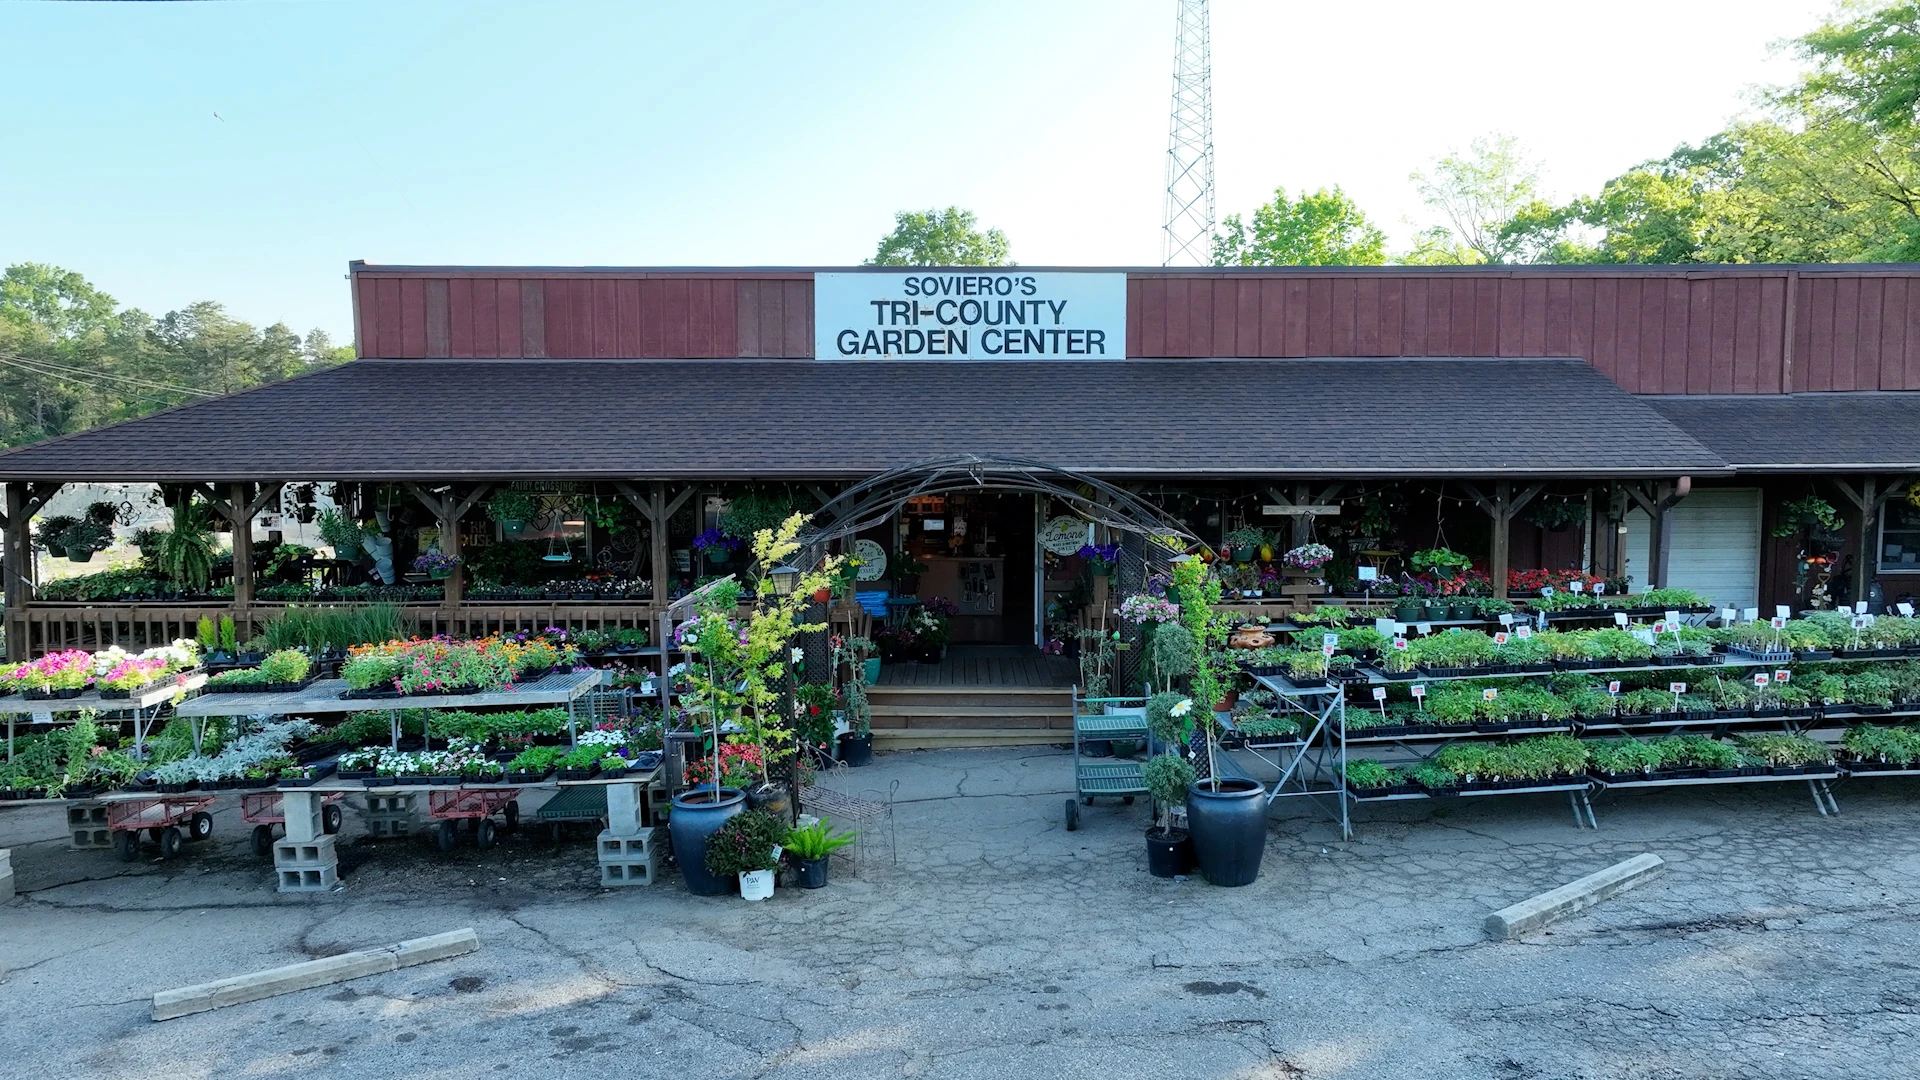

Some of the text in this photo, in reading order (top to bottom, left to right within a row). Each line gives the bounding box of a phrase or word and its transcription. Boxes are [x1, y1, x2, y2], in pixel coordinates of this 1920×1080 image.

[903, 276, 1037, 296] SOVIERO'S
[870, 299, 1067, 326] TRI-COUNTY
[836, 328, 1105, 355] GARDEN CENTER
[510, 481, 574, 492] FAIRY CROSSING
[1045, 530, 1086, 542] Lemons
